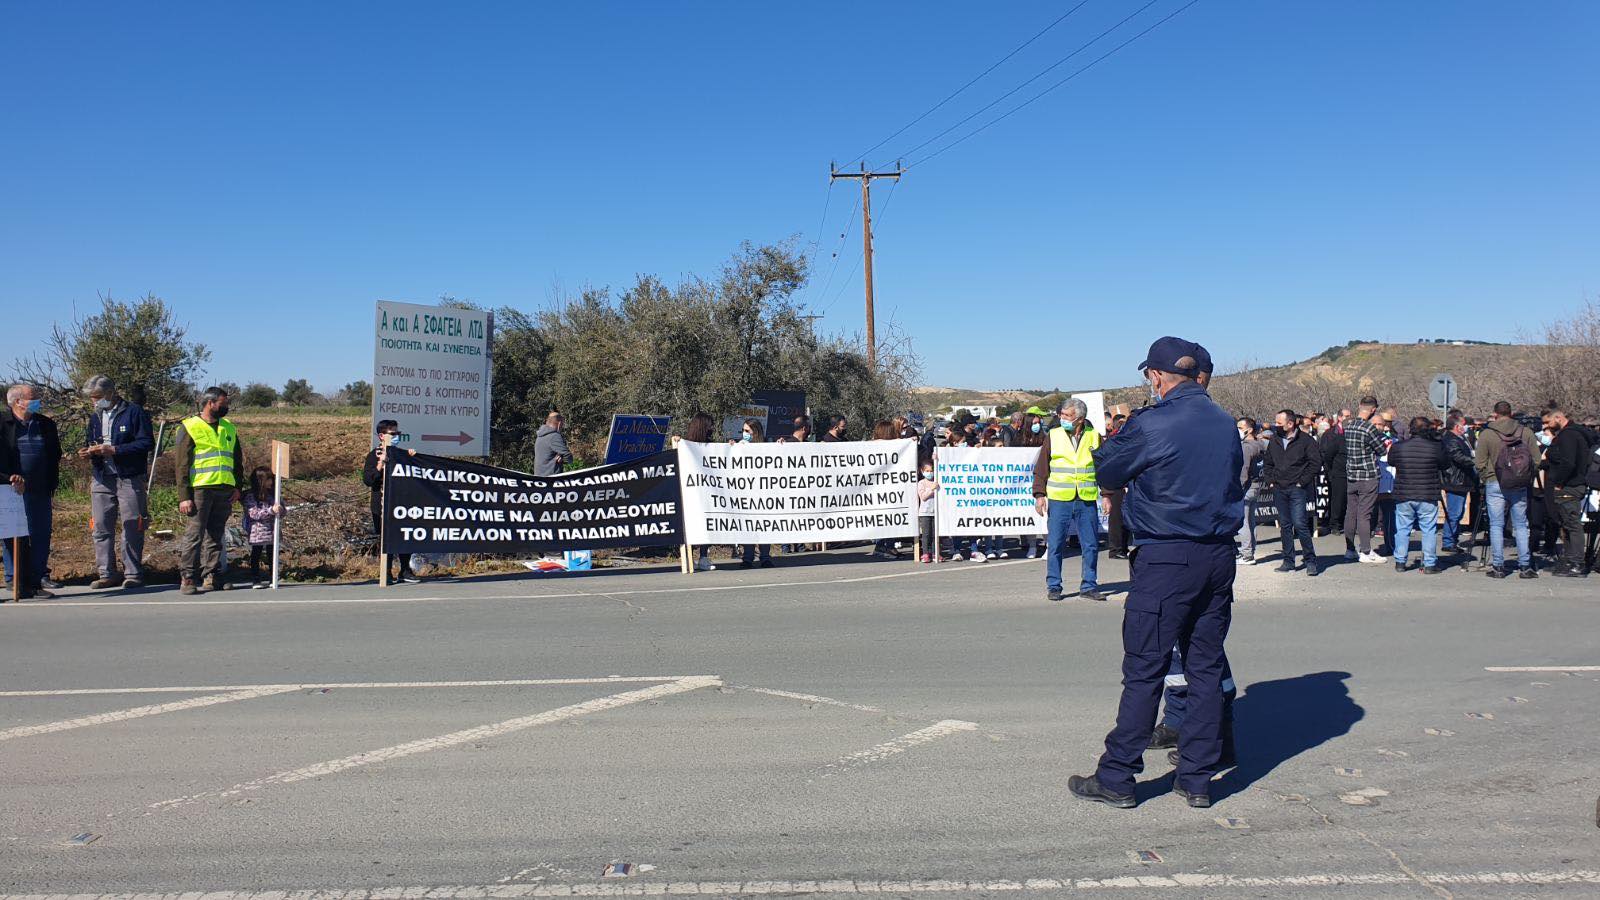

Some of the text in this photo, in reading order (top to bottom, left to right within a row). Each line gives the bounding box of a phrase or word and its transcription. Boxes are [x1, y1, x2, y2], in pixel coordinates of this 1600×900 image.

[382, 311, 483, 339] Α και Α ΣΦΑΓΕΙΑ ΛΤΔ
[382, 339, 481, 356] ΠΟΙΟΤΗΤΑ ΚΑΙ ΣΥΝΕΠΕΙΑ
[382, 366, 480, 383] ΣΥΝΤΟΜΑ ΤΟ ΠΙΟ ΣΥΓΧΡΟΝΟ
[381, 385, 478, 399] ΣΦΑΓΕΙΟ & ΚΟΠΤΗΡΙΟ
[380, 403, 480, 416] ΚΡΕΑΤΩΝ ΣΤΗΝ ΚΥΠΡΟ
[703, 452, 899, 469] ΔΕΝ ΜΠΟΡΩ ΝΑ ΠΙΣΤΕΨΩ ΟΤΙ Ο
[949, 464, 978, 472] ΥΓΕΙΑ
[982, 464, 1003, 472] ΤΩΝ
[392, 464, 518, 488] ΔΙΕΚΔΙΚΟΥΜΕ
[552, 470, 638, 488] ΔΙΚΑΙΩΜΑ
[643, 464, 676, 478] ΜΑΣ
[686, 471, 916, 490] ΔΙΚΟΣ ΜΟΥ ΠΡΟΕΔΡΟΣ ΚΑΤΑΣΤΡΕΦΕ
[449, 488, 630, 503] ΣΤΟΝ ΚΑΘΑΡΟ ΑΕΡΑ.
[711, 491, 905, 510] ΤΟ ΜΕΛΛΟΝ ΤΩΝ ΠΑΙΔΙΩΝ ΜΟΥ
[956, 499, 1034, 507] ΣΥΜΦΕΡΟΝΤΩΝ
[393, 502, 676, 522] ΟΦΕΙΛΟΥΜΕ ΝΑ ΔΙΑΦΥΛΑΞΟΥΜΕ
[707, 512, 909, 532] ΕΙΝΑΙ ΠΑΡΑΠΛΗΡΟΦΟΡΗΜΕΝΟΣ
[957, 517, 1035, 527] ΑΓΡΟΚΗΠΙΑ
[401, 522, 674, 541] ΤΟ ΜΕΛΛΟΝ ΤΩΝ ΠΑΙΔΙΩΝ ΜΑΣ.
